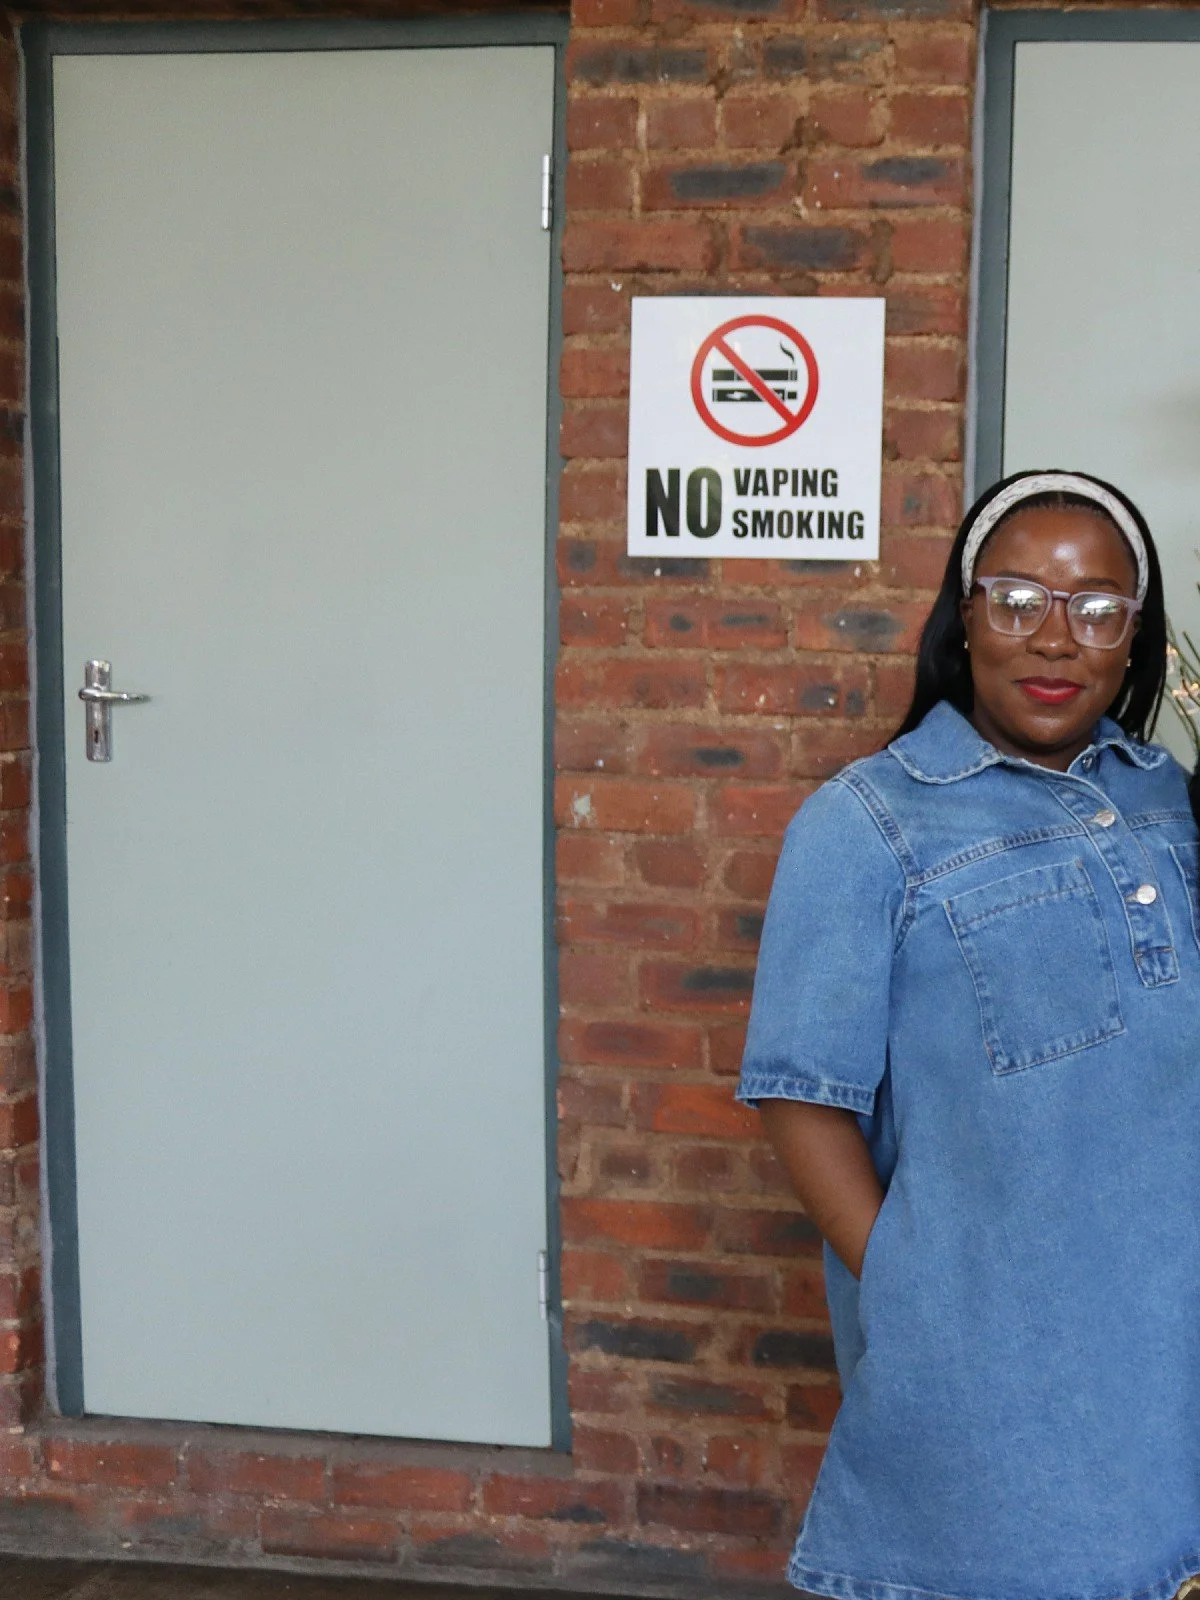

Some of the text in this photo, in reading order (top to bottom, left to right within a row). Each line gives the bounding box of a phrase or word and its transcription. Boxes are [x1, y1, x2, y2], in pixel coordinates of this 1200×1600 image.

[645, 466, 838, 538] NO VAPING
[731, 509, 865, 539] SMOKING
